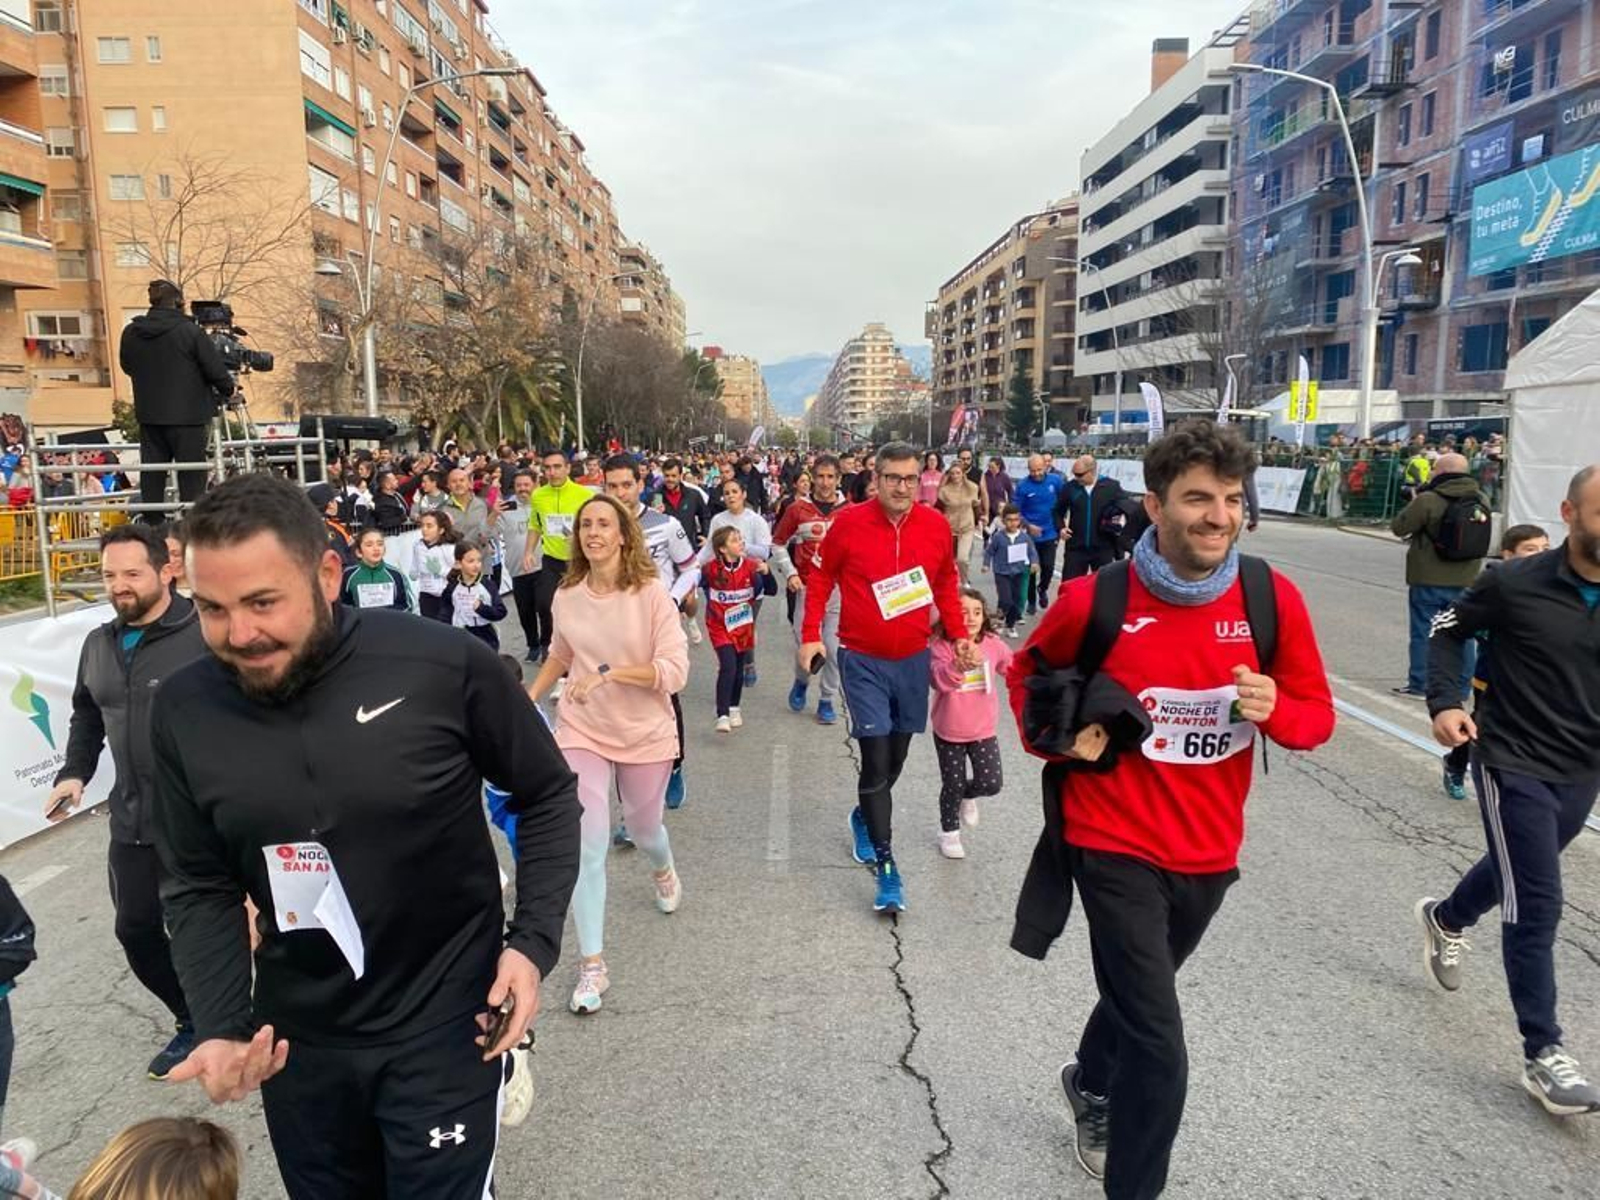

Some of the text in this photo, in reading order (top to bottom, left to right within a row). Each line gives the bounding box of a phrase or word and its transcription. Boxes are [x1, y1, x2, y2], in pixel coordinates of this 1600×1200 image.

[1476, 197, 1522, 221] Destino,
[1477, 216, 1519, 238] tu meta
[1150, 714, 1170, 724] AN
[1160, 705, 1219, 716] NOCHE DE
[1184, 732, 1231, 758] 666
[15, 759, 53, 779] Patronato
[283, 862, 311, 872] SAN
